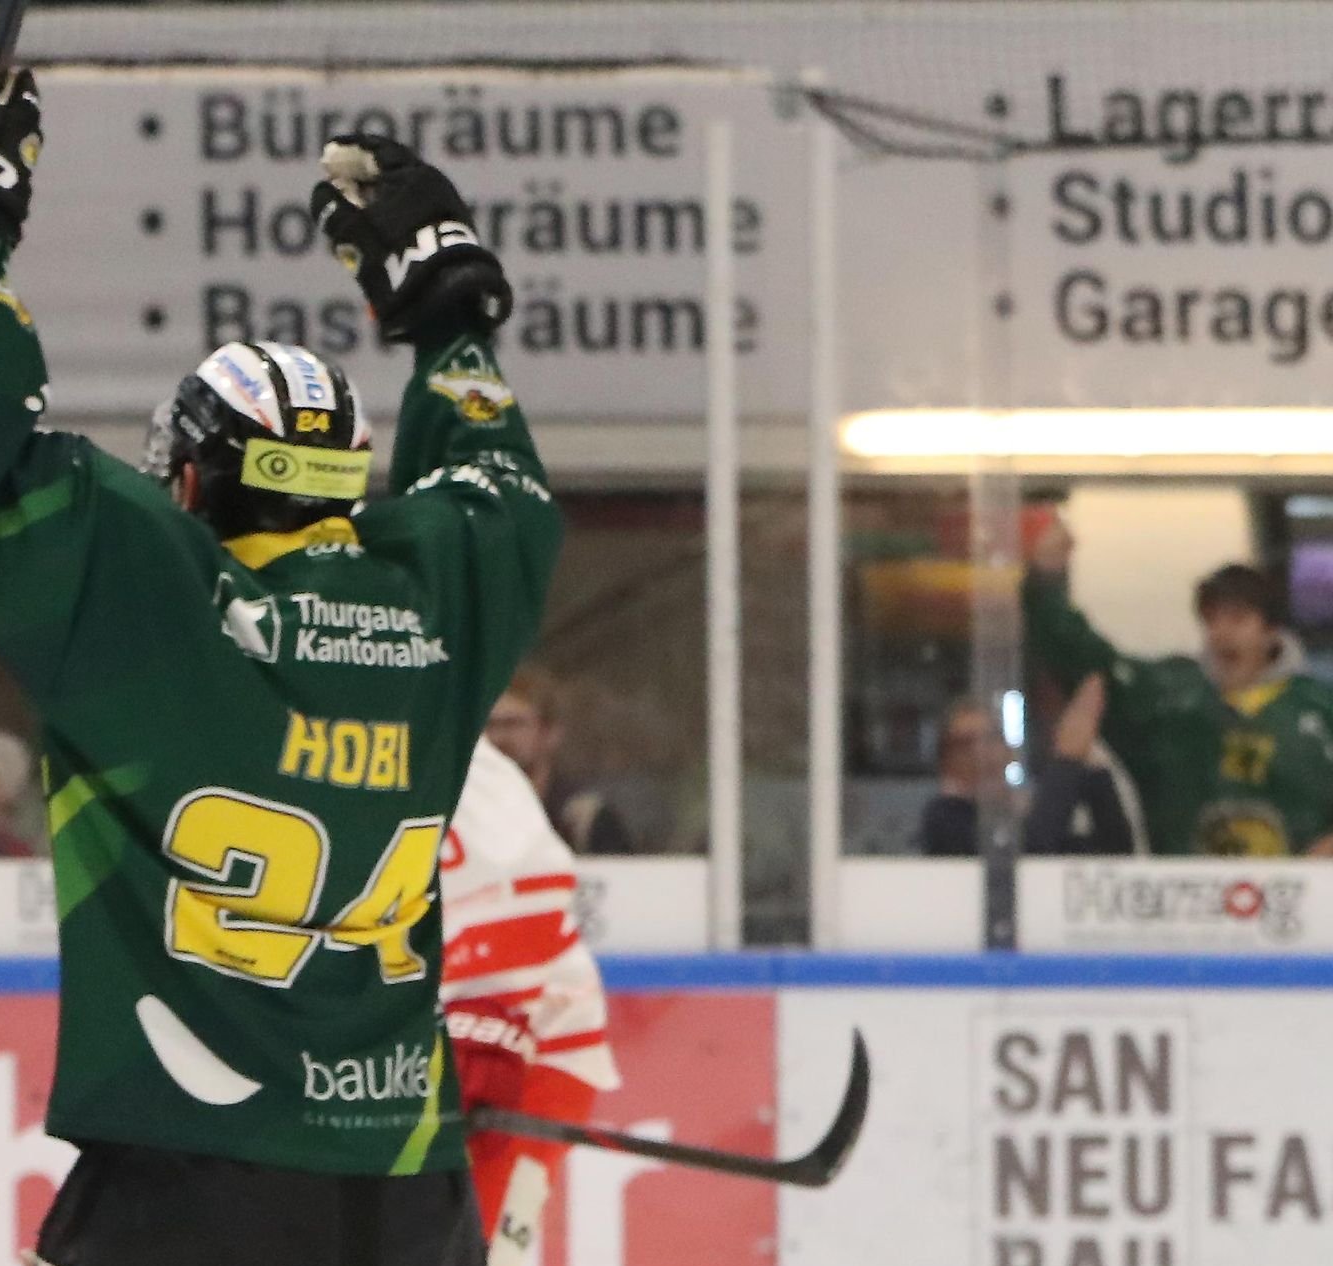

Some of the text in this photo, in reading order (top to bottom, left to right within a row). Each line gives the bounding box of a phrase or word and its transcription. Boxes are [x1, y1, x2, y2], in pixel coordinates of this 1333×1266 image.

[200, 178, 763, 257] Horäume
[1051, 166, 1333, 246] Studio
[383, 219, 480, 293] CM
[200, 282, 761, 362] Basäume
[295, 408, 331, 433] 24
[277, 708, 411, 792] HOBI
[161, 784, 447, 990] 24
[993, 1030, 1173, 1118] SAN
[993, 1134, 1323, 1223] NEU FA
